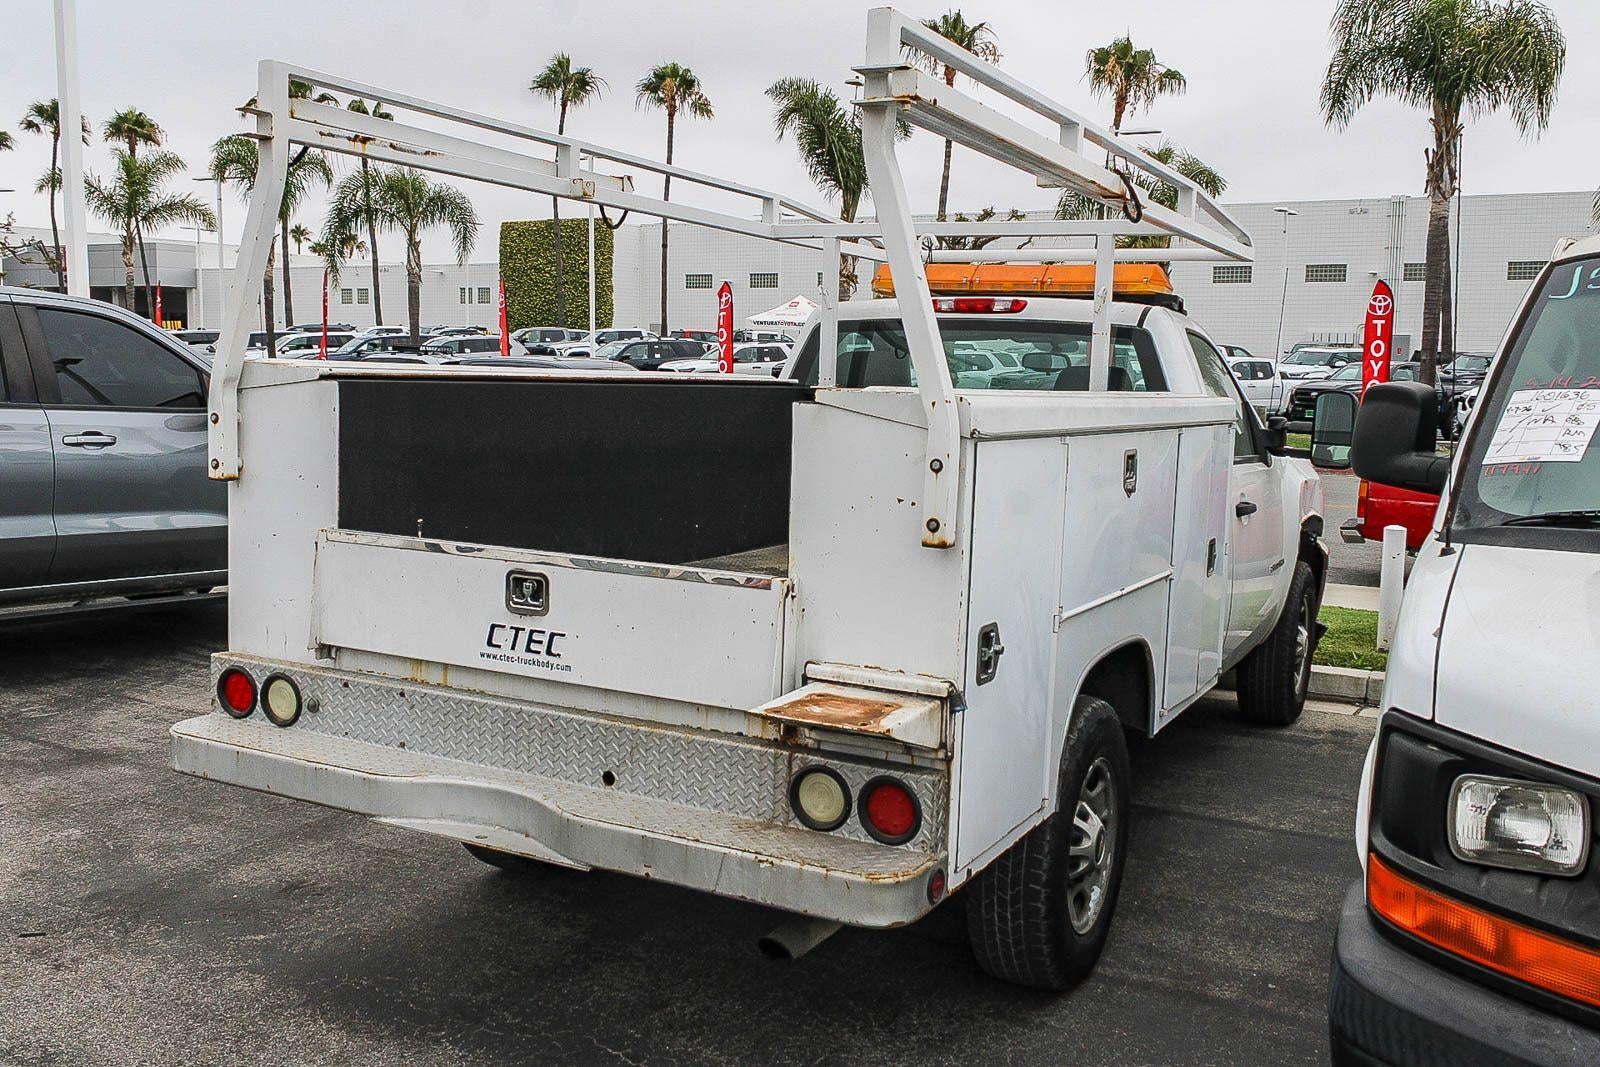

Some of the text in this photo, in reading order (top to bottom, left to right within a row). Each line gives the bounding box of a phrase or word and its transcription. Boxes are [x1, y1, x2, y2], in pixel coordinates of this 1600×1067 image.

[719, 311, 728, 373] TOYO
[486, 623, 566, 658] CTEC
[479, 651, 572, 672] www.ctec-truckbody.com
